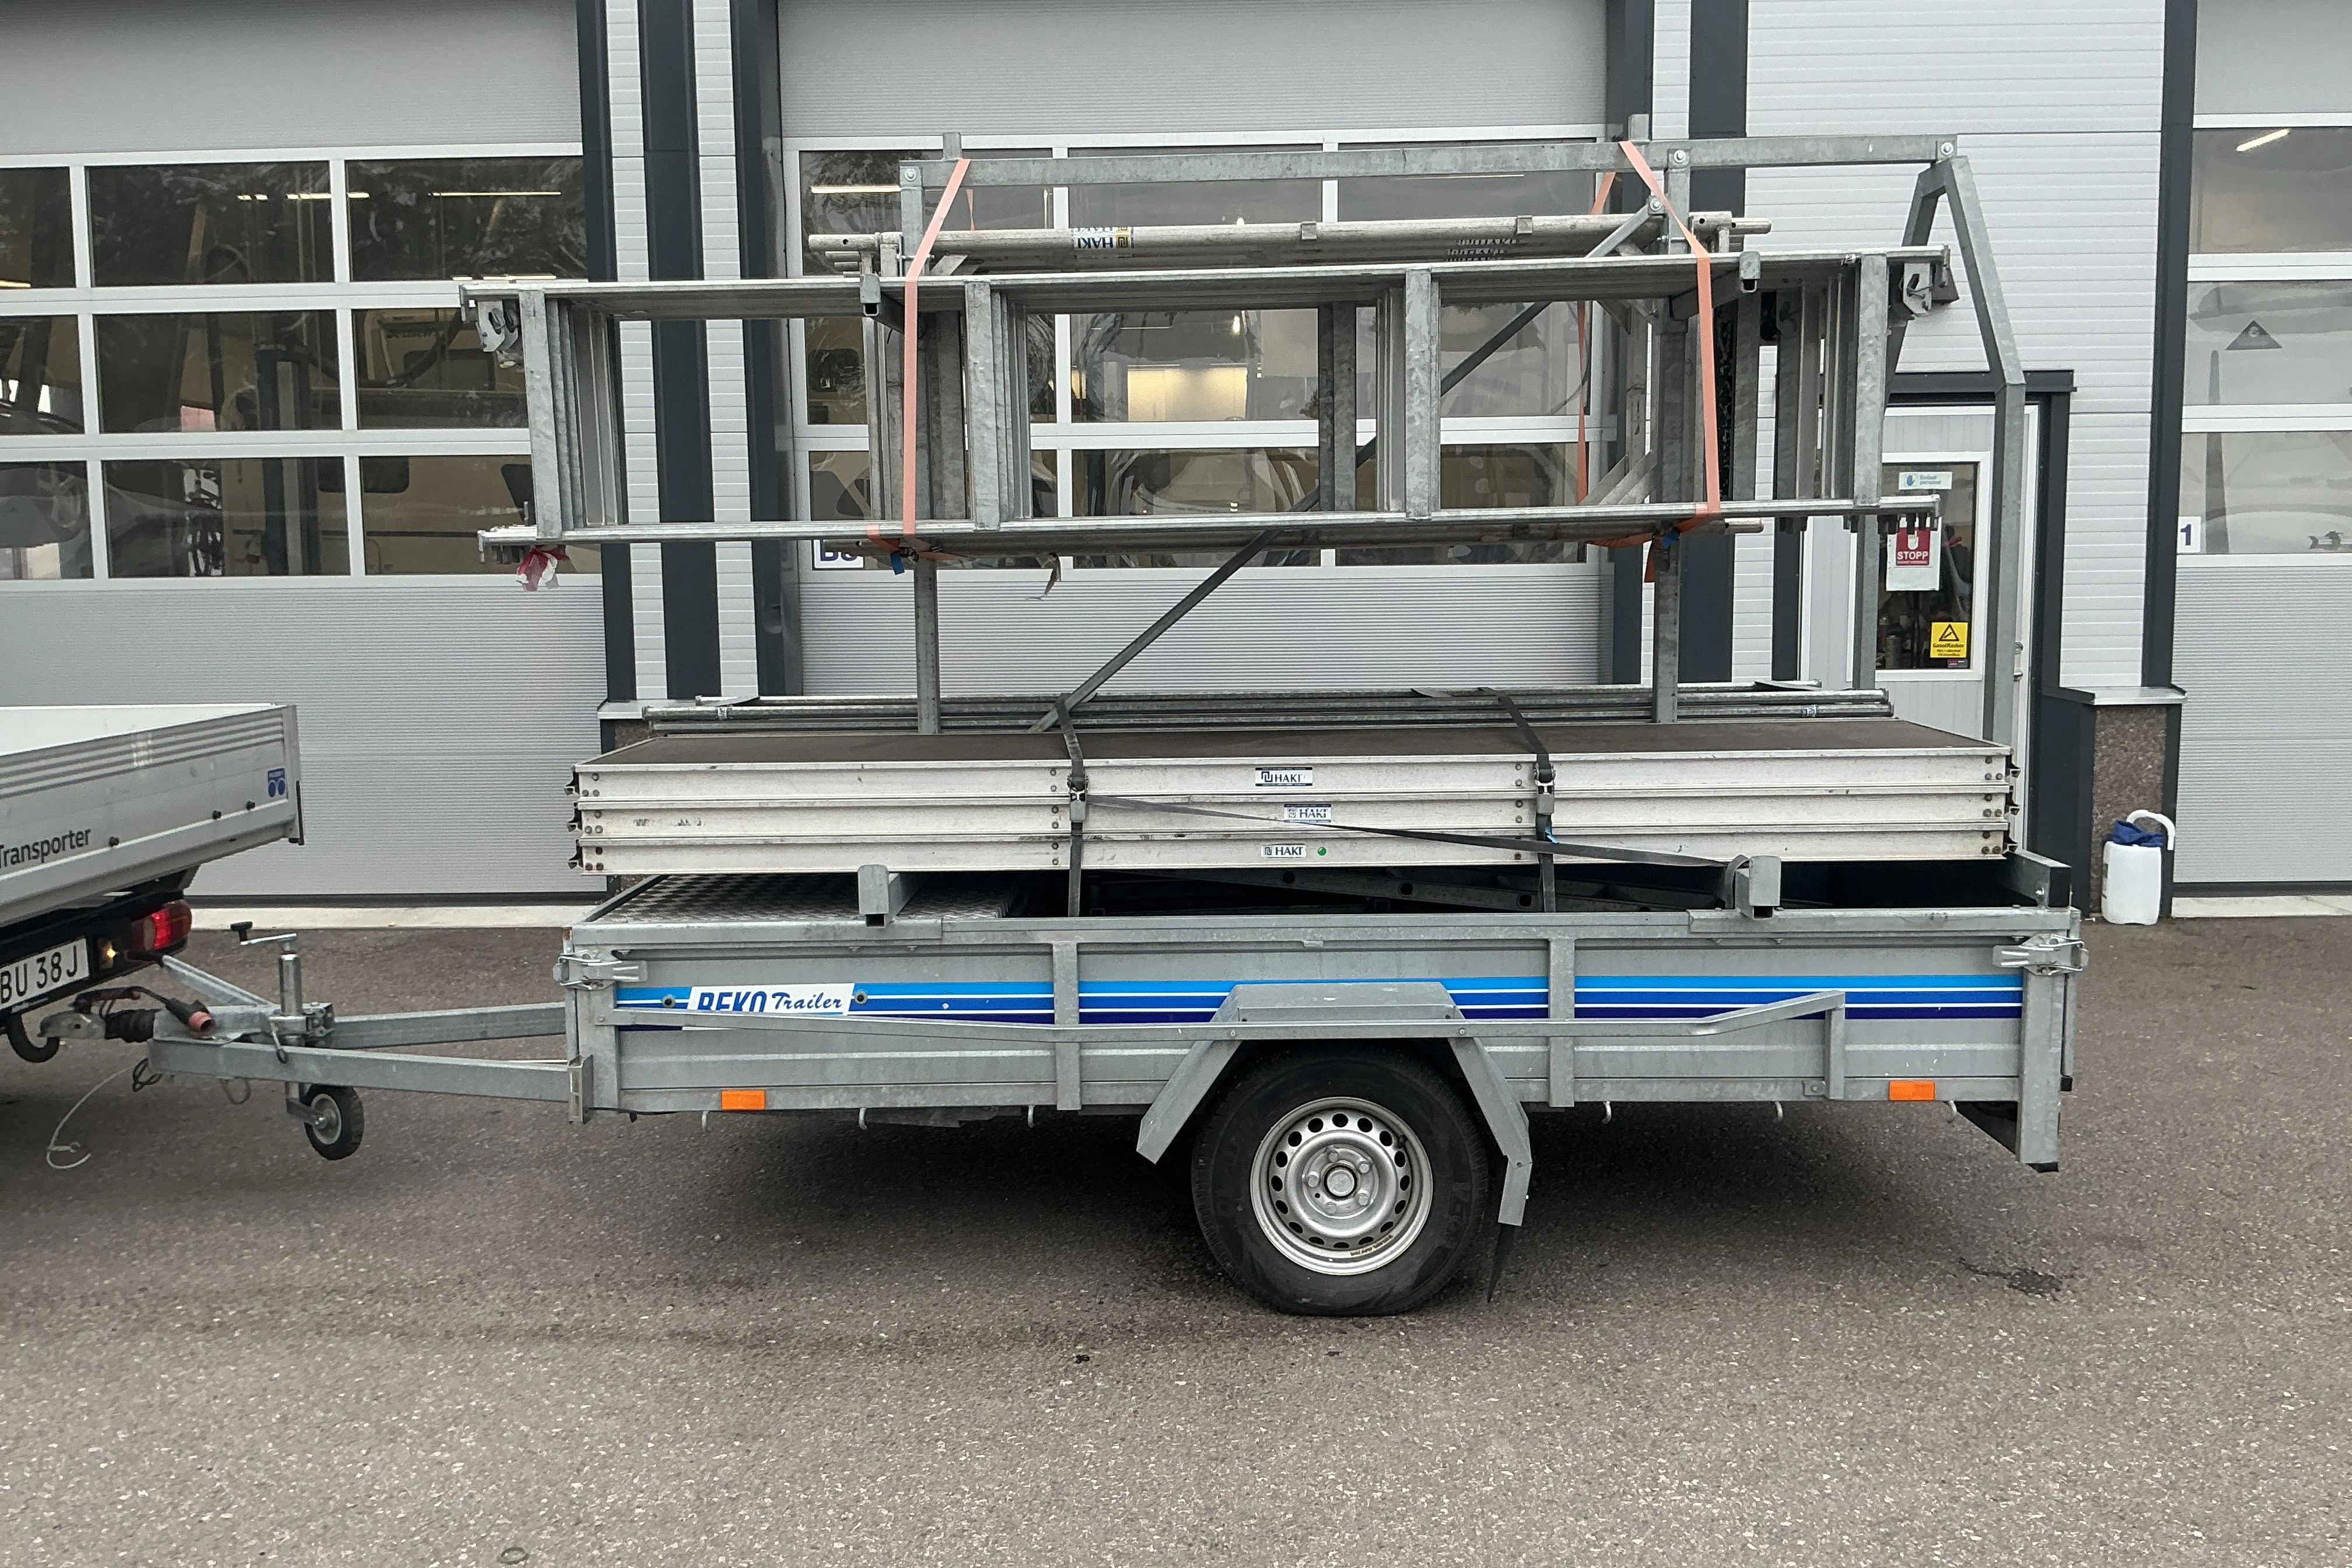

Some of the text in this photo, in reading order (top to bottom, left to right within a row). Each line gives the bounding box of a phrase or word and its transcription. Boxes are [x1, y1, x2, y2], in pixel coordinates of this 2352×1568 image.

[1077, 236, 1114, 249] HAKI
[2180, 524, 2192, 546] 1
[1897, 551, 1929, 560] STOPP
[1275, 774, 1301, 783] HAKI
[1299, 808, 1327, 818] HAKI
[1275, 846, 1303, 856] HAKI
[771, 992, 842, 1010] Trailer
